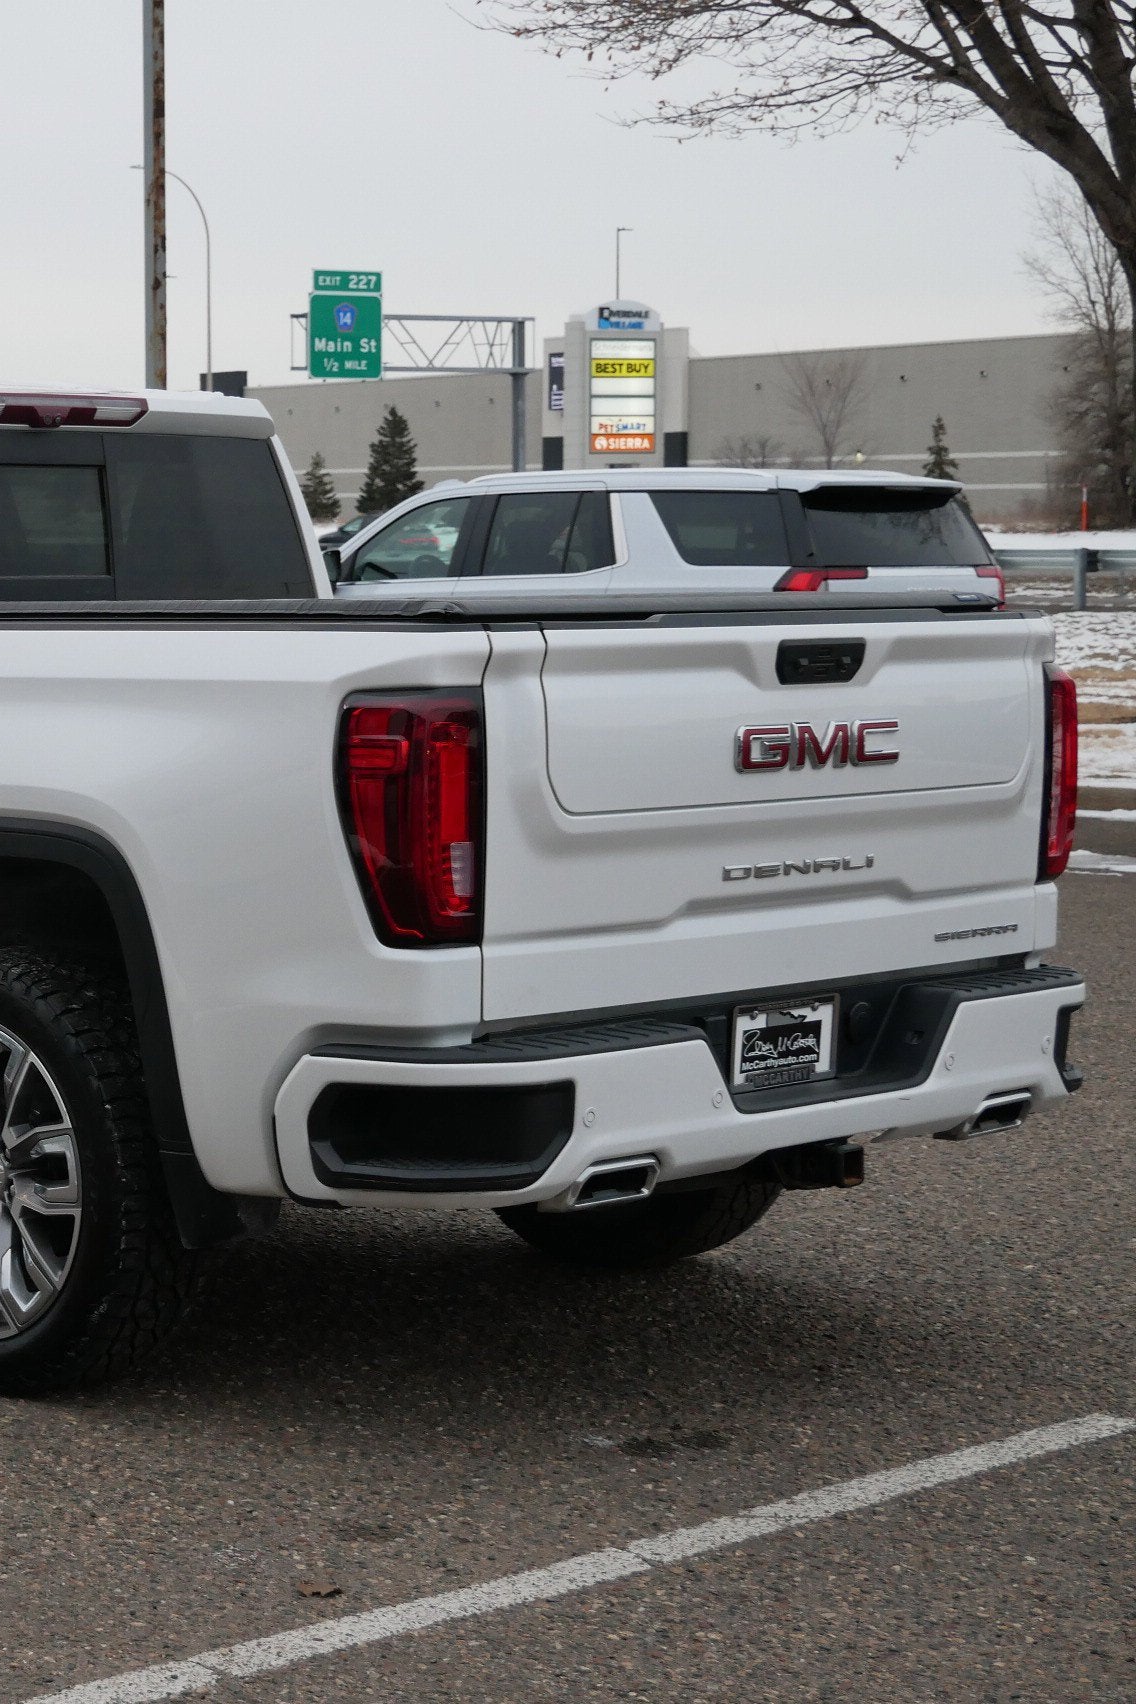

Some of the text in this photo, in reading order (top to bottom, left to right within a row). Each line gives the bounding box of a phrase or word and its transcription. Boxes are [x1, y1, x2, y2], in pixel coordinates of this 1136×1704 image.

[318, 275, 378, 289] EXIT 227
[339, 312, 351, 325] 14
[314, 337, 377, 353] Main St
[344, 360, 368, 370] MILE
[595, 363, 651, 374] BEST BUY
[609, 437, 651, 449] SIERRA
[734, 718, 900, 774] GMC
[722, 853, 875, 881] DENALI
[934, 923, 1018, 942] SIERRA
[741, 1053, 818, 1071] McCarthyauto.com
